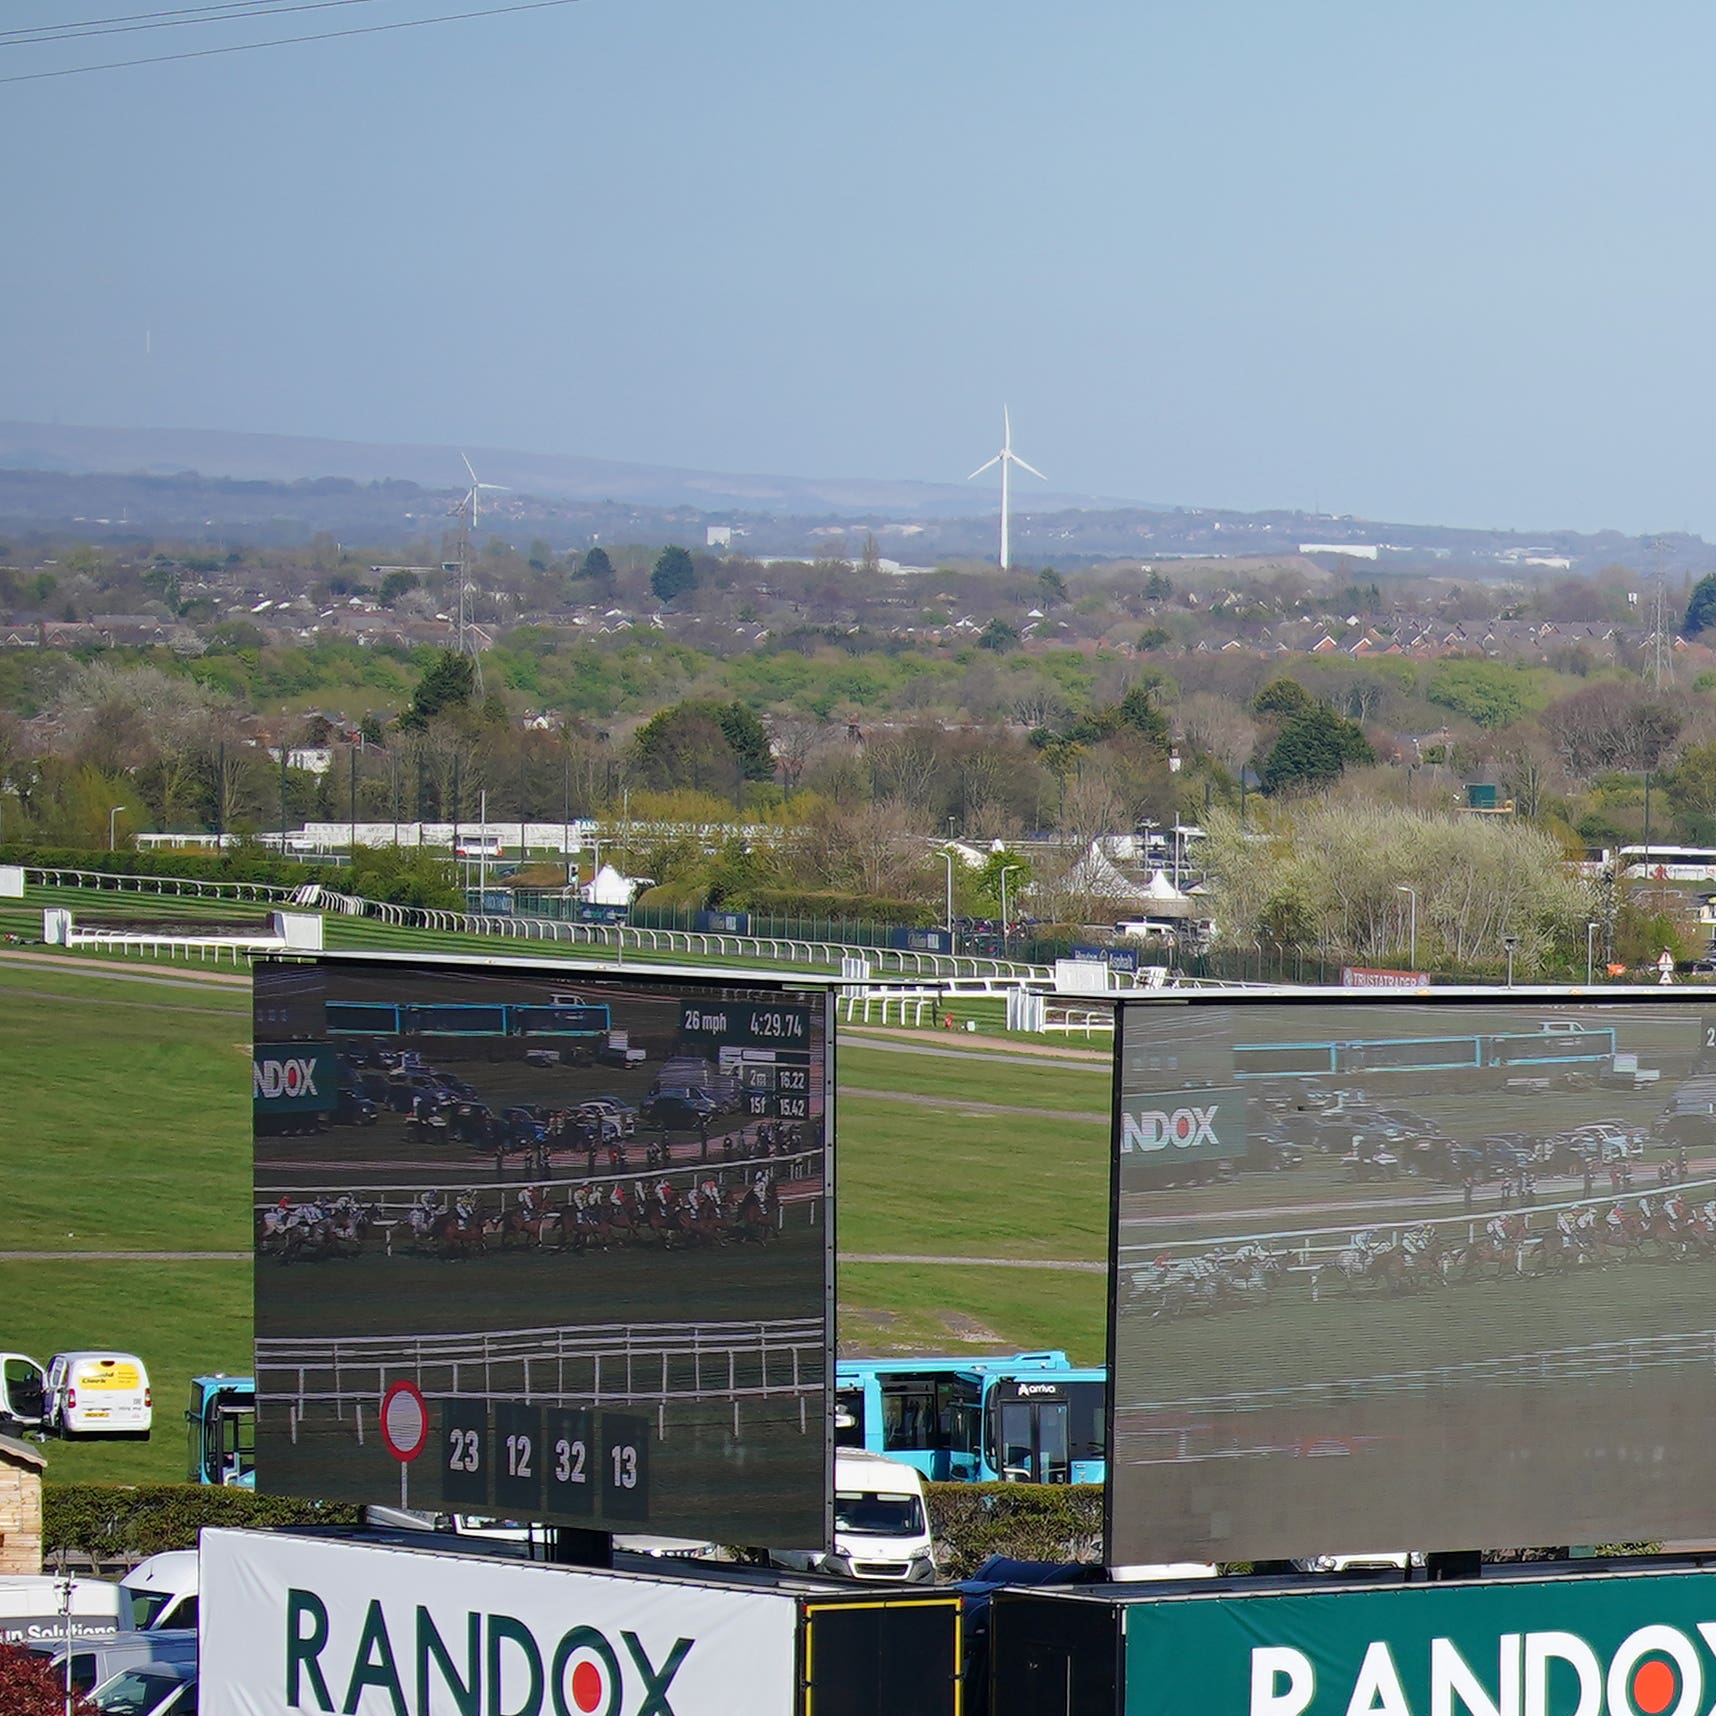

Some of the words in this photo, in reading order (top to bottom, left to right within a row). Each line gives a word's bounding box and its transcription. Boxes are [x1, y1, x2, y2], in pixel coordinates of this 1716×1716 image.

[685, 1010, 700, 1030] 26
[702, 1013, 727, 1036] mph
[750, 1012, 802, 1037] 4:29.74
[780, 1071, 805, 1090] 16.22
[780, 1099, 805, 1117] 15.42
[1121, 1105, 1220, 1154] NDOX
[449, 1428, 479, 1472] 23
[507, 1435, 532, 1478] 12
[555, 1439, 586, 1484] 32
[611, 1444, 637, 1489] 13
